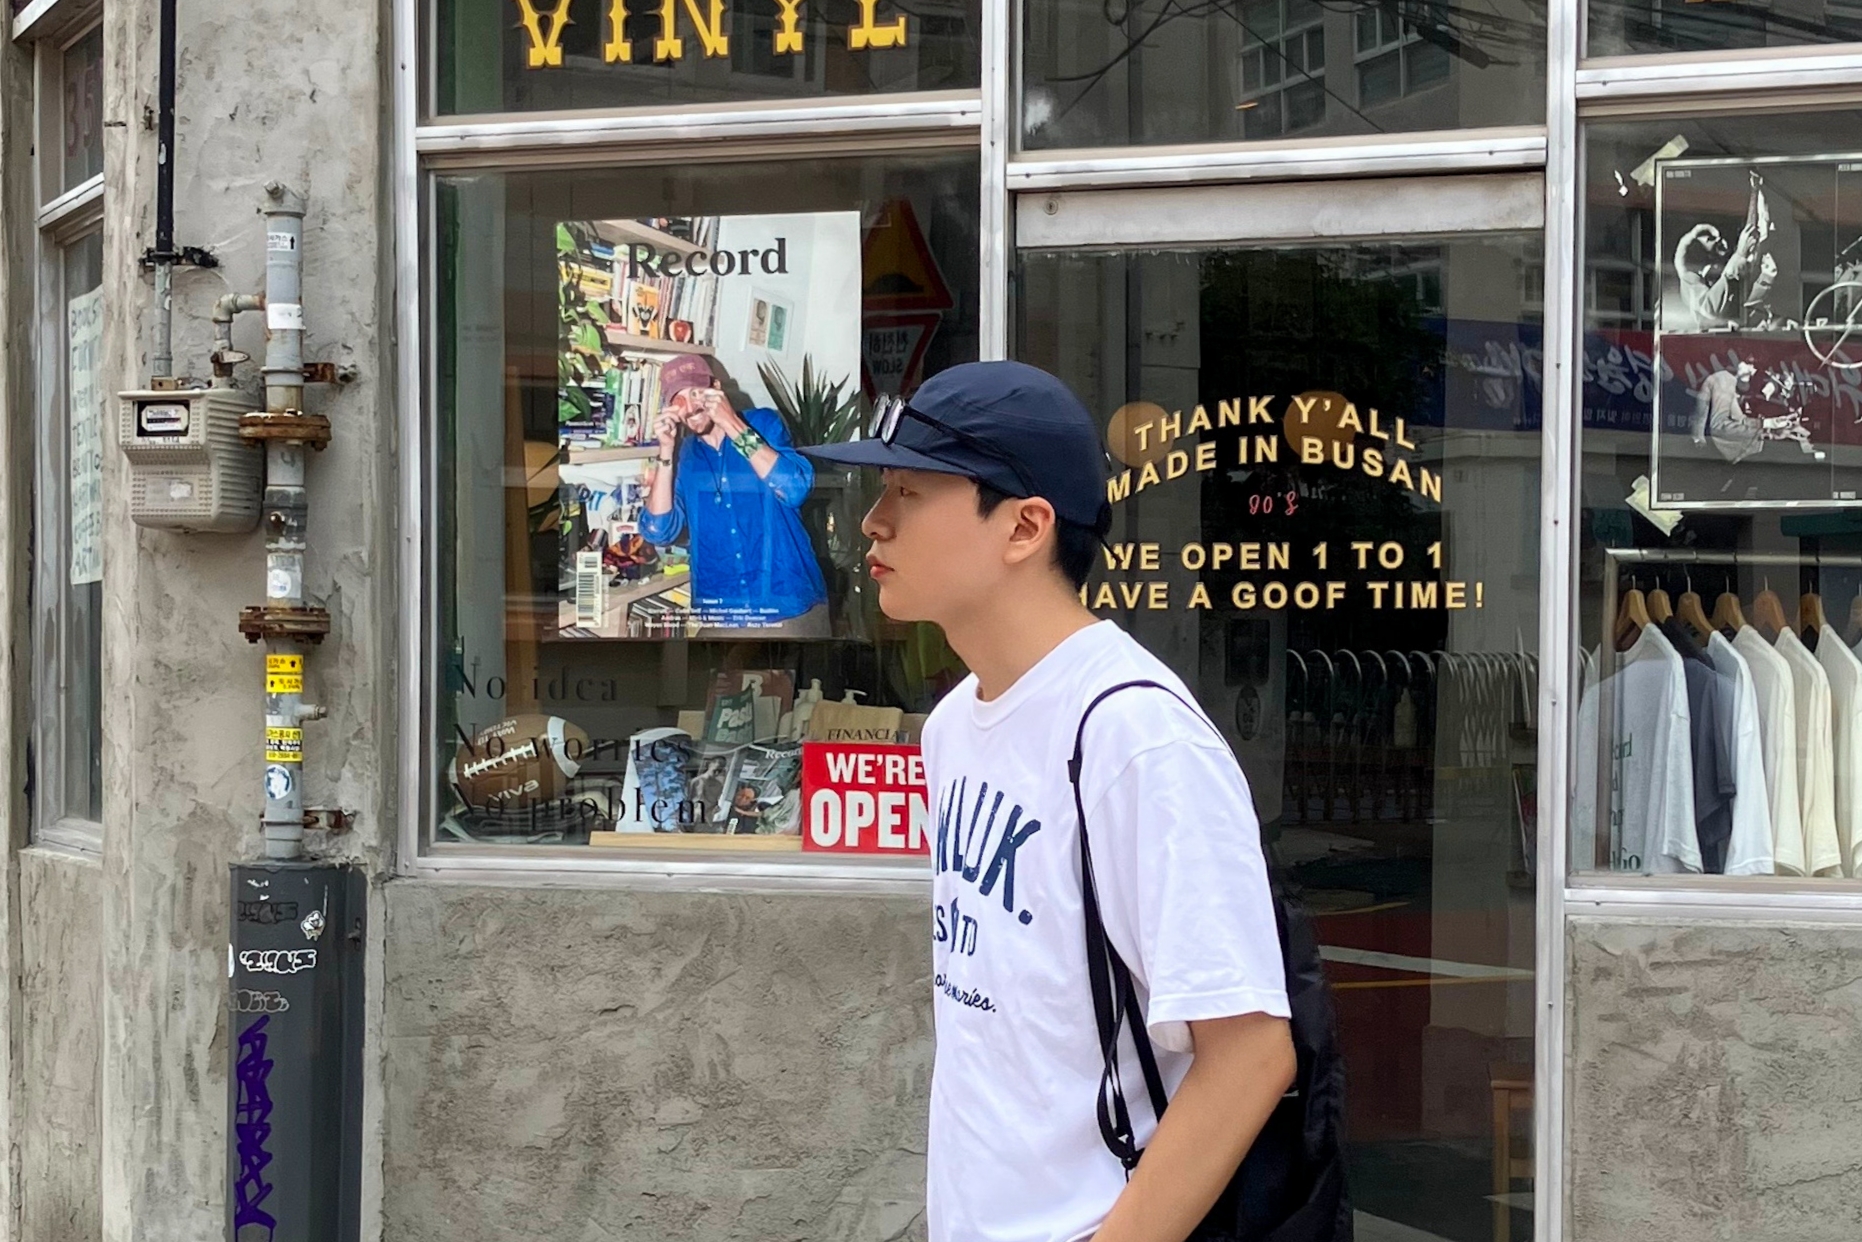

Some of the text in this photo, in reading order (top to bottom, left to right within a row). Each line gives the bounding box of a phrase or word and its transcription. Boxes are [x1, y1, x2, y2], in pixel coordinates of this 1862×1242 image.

[626, 237, 789, 279] Record
[1134, 394, 1416, 451] THANK Y'ALL
[1106, 434, 1443, 505] MADE IN BUSAN
[1104, 540, 1442, 571] WE OPEN 1 TO 1
[1187, 581, 1214, 610] A
[1231, 580, 1347, 611] GOOF
[1366, 581, 1484, 610] TIME!
[454, 663, 618, 701] No idea
[453, 723, 506, 758] No
[529, 728, 692, 763] worries
[825, 752, 928, 786] WE'RE
[453, 782, 707, 832] No problem
